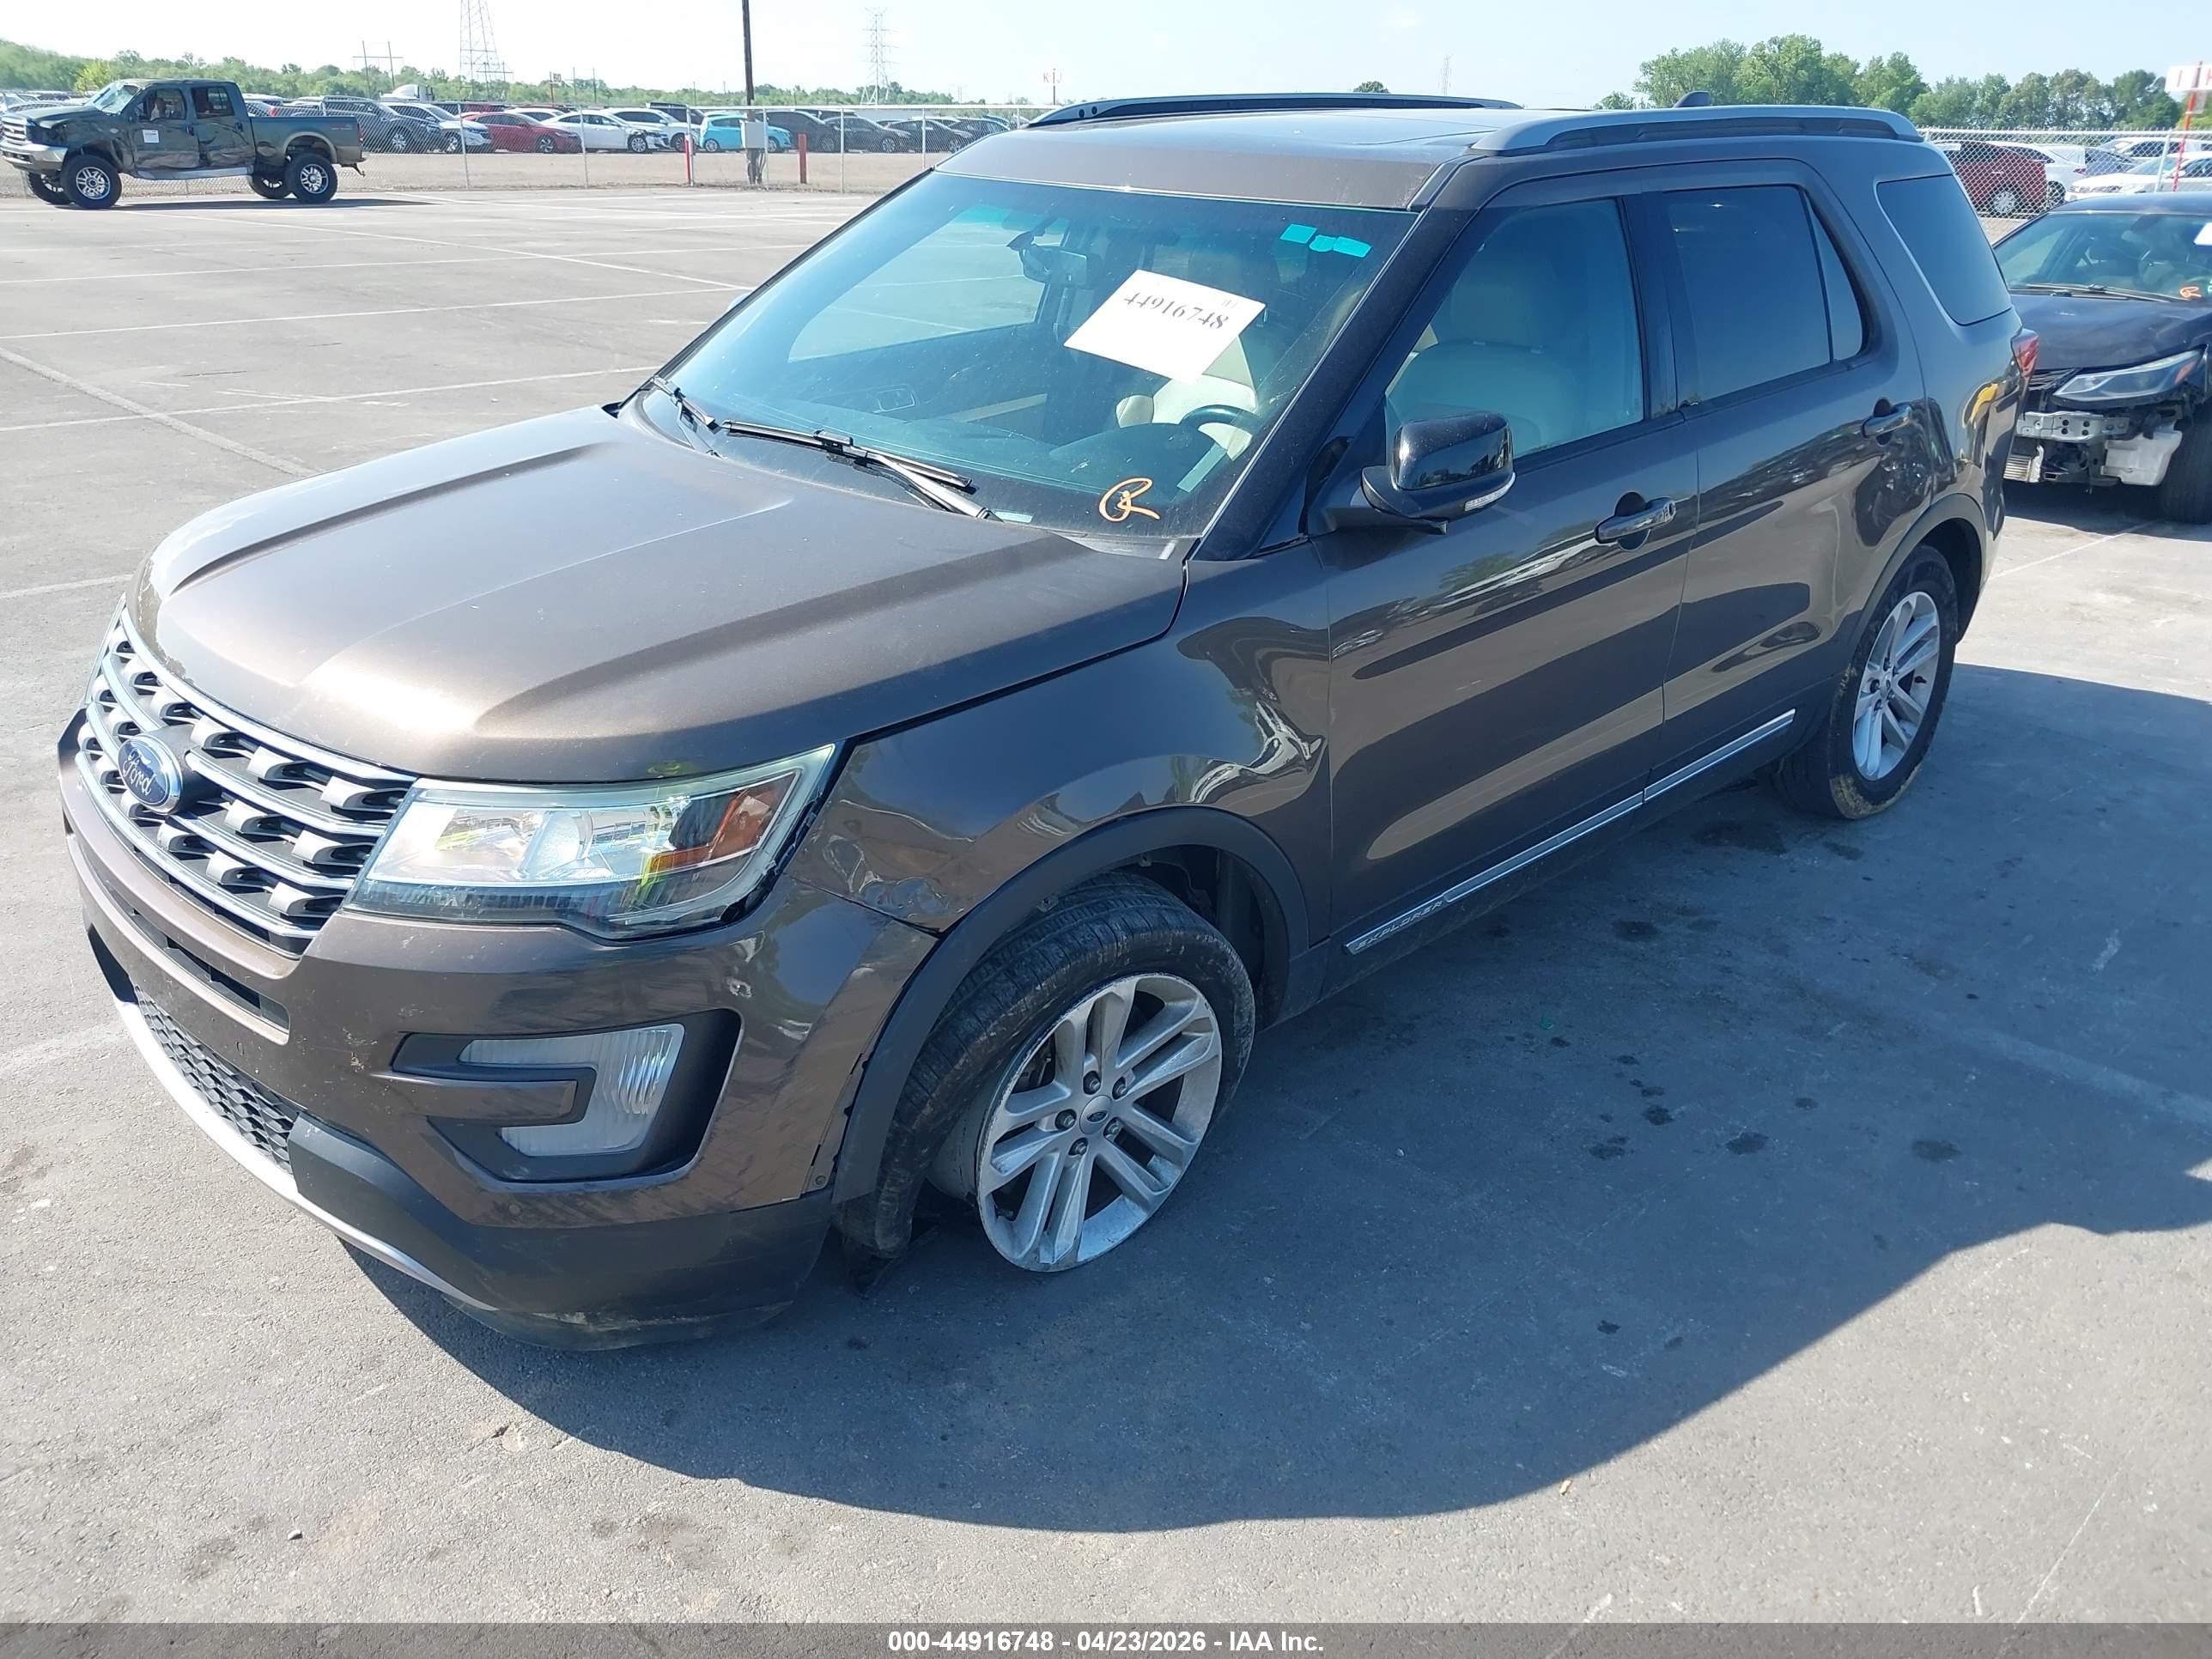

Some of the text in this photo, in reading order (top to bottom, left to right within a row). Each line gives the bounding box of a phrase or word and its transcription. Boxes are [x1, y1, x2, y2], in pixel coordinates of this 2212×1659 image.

[1124, 292, 1229, 329] 44916748
[122, 747, 157, 796] Ford
[1355, 900, 1443, 951] EXPLORER
